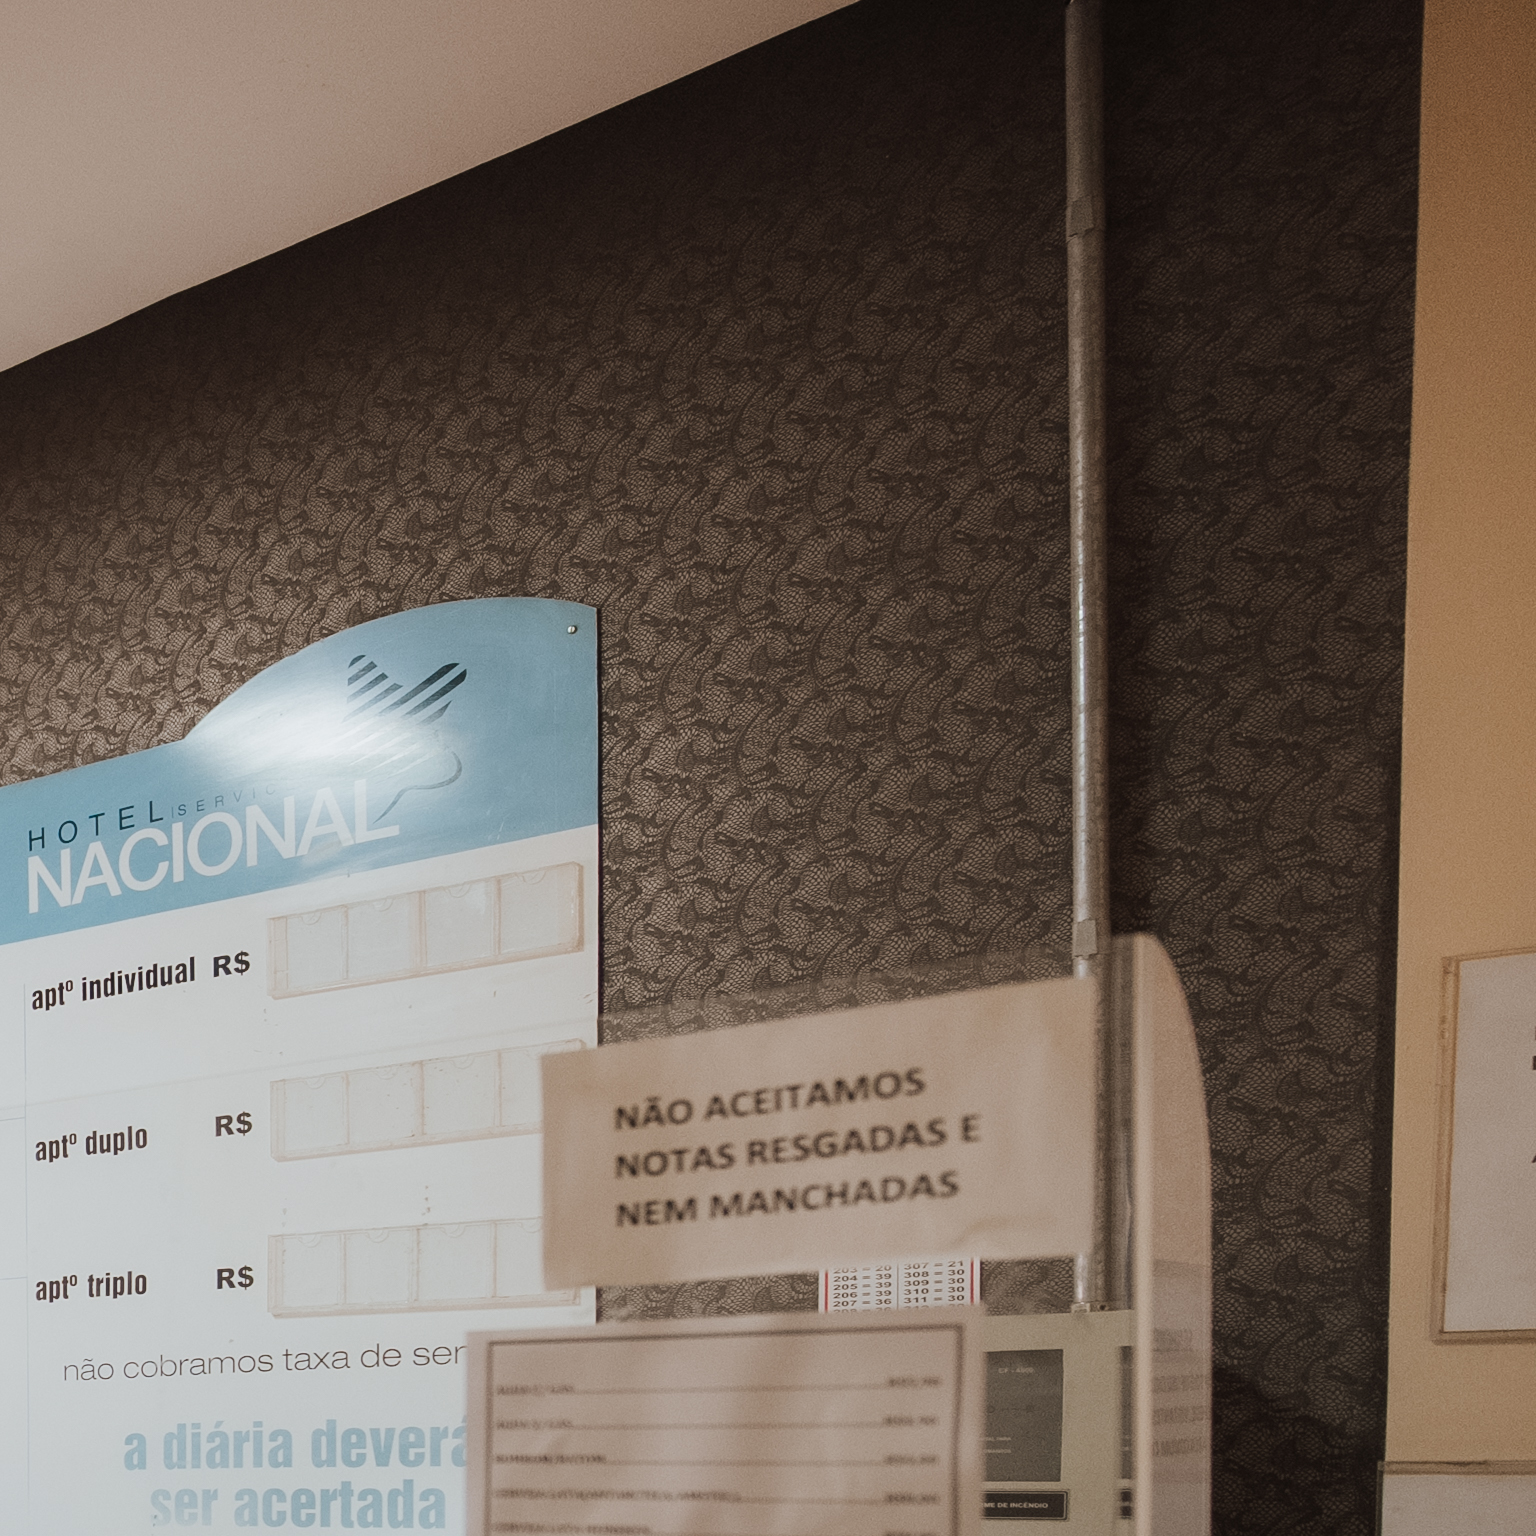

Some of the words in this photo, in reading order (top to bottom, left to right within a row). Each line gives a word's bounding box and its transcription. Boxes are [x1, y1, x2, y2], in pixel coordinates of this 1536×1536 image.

[28, 800, 165, 852] HOTEL
[177, 780, 280, 817] SERVIC
[28, 778, 400, 915] NACIONAL
[81, 956, 196, 1002] individual
[212, 950, 251, 978] R$
[615, 1097, 694, 1131] NÃO
[704, 1067, 926, 1121] ACEITAMOS
[85, 1127, 148, 1158] duplo
[214, 1111, 253, 1137] R$
[615, 1143, 735, 1179] NOTAS
[746, 1117, 947, 1166] RESGADAS
[961, 1113, 981, 1143] E
[616, 1197, 698, 1228] NEM
[708, 1170, 961, 1219] MANCHADAS
[87, 1270, 148, 1300] triplo
[216, 1266, 254, 1290] R$
[63, 1358, 115, 1381] não
[123, 1354, 274, 1379] cobramos
[282, 1348, 351, 1371] taxa
[360, 1343, 402, 1368] de
[412, 1345, 467, 1366] ser
[123, 1432, 147, 1471] a
[163, 1420, 293, 1471] diária
[150, 1485, 219, 1528] ser
[234, 1479, 446, 1529] acertada
